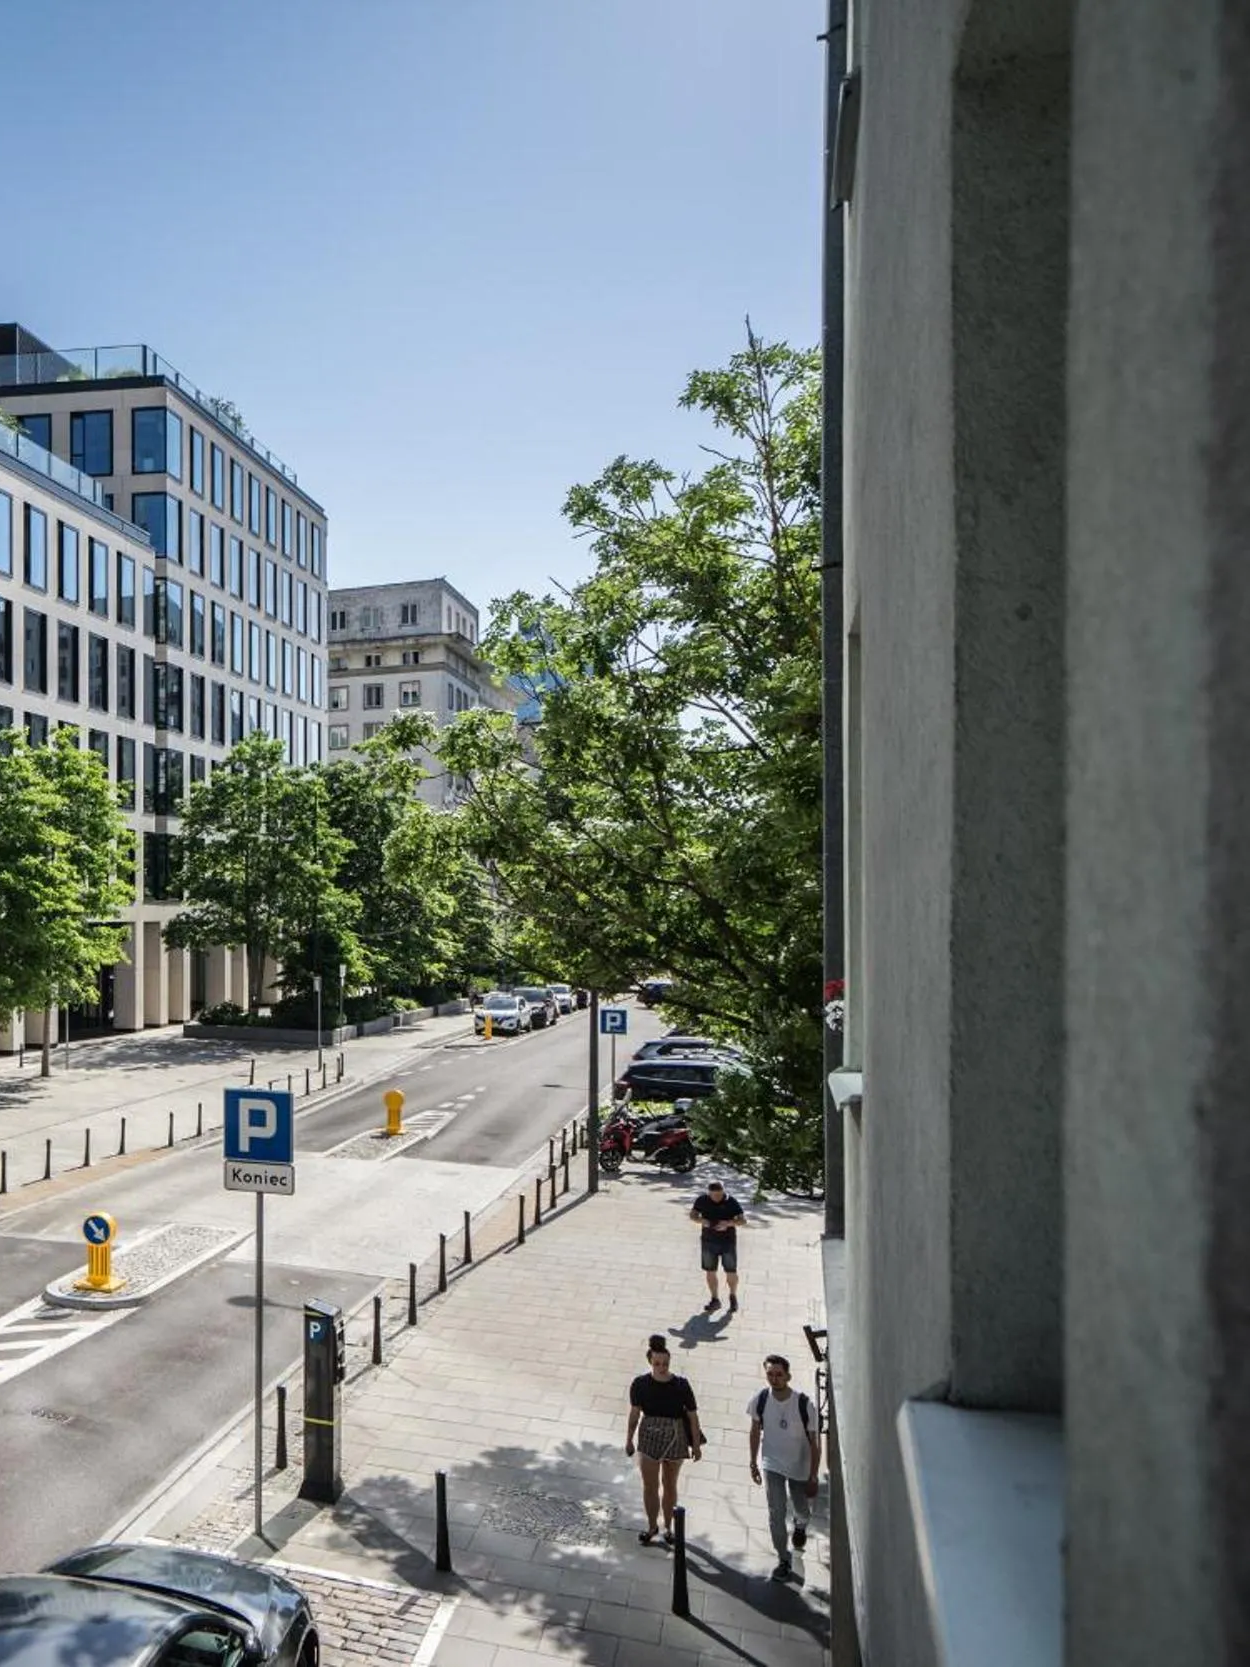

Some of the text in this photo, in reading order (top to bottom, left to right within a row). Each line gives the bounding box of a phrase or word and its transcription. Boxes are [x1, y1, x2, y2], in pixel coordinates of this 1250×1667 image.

[606, 1012, 622, 1032] P
[238, 1098, 277, 1153] P
[232, 1168, 288, 1187] Koniec
[309, 1322, 321, 1339] P
